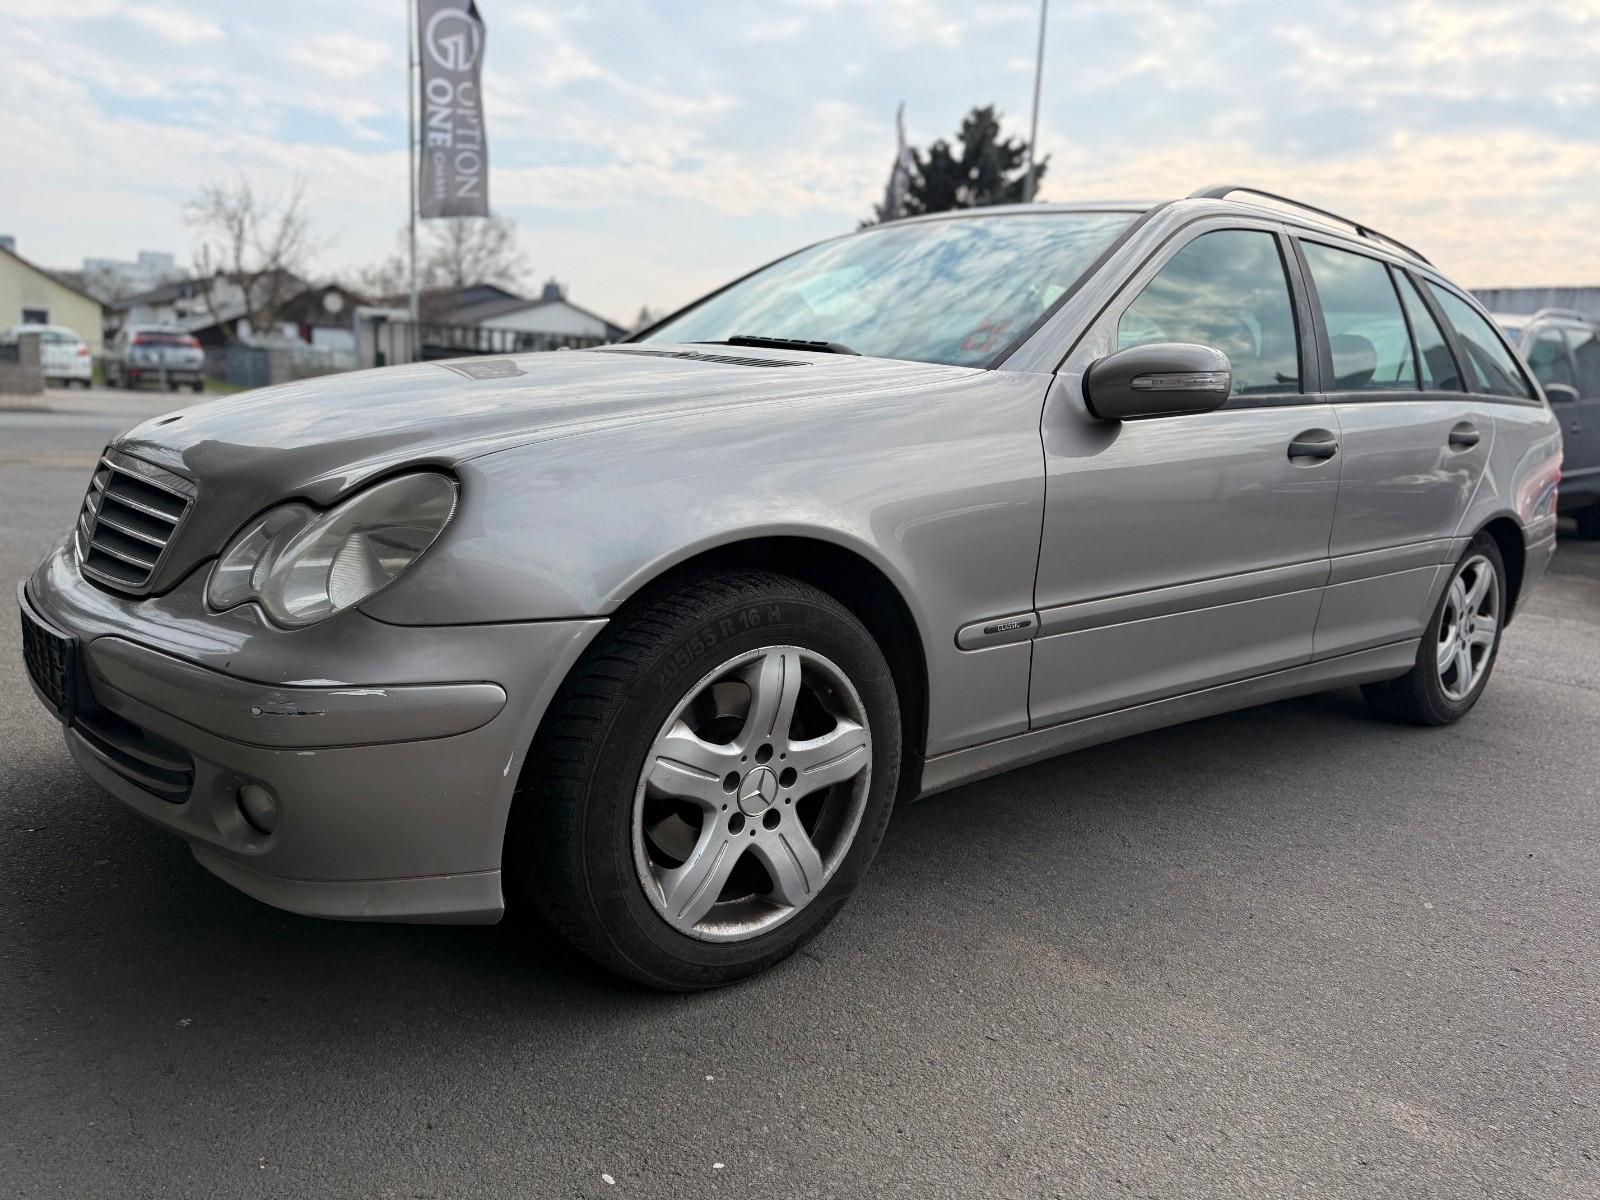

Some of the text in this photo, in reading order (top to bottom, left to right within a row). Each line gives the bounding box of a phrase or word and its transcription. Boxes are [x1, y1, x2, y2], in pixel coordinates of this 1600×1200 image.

[427, 78, 453, 147] ONE
[719, 618, 736, 638] R
[738, 609, 760, 629] 16
